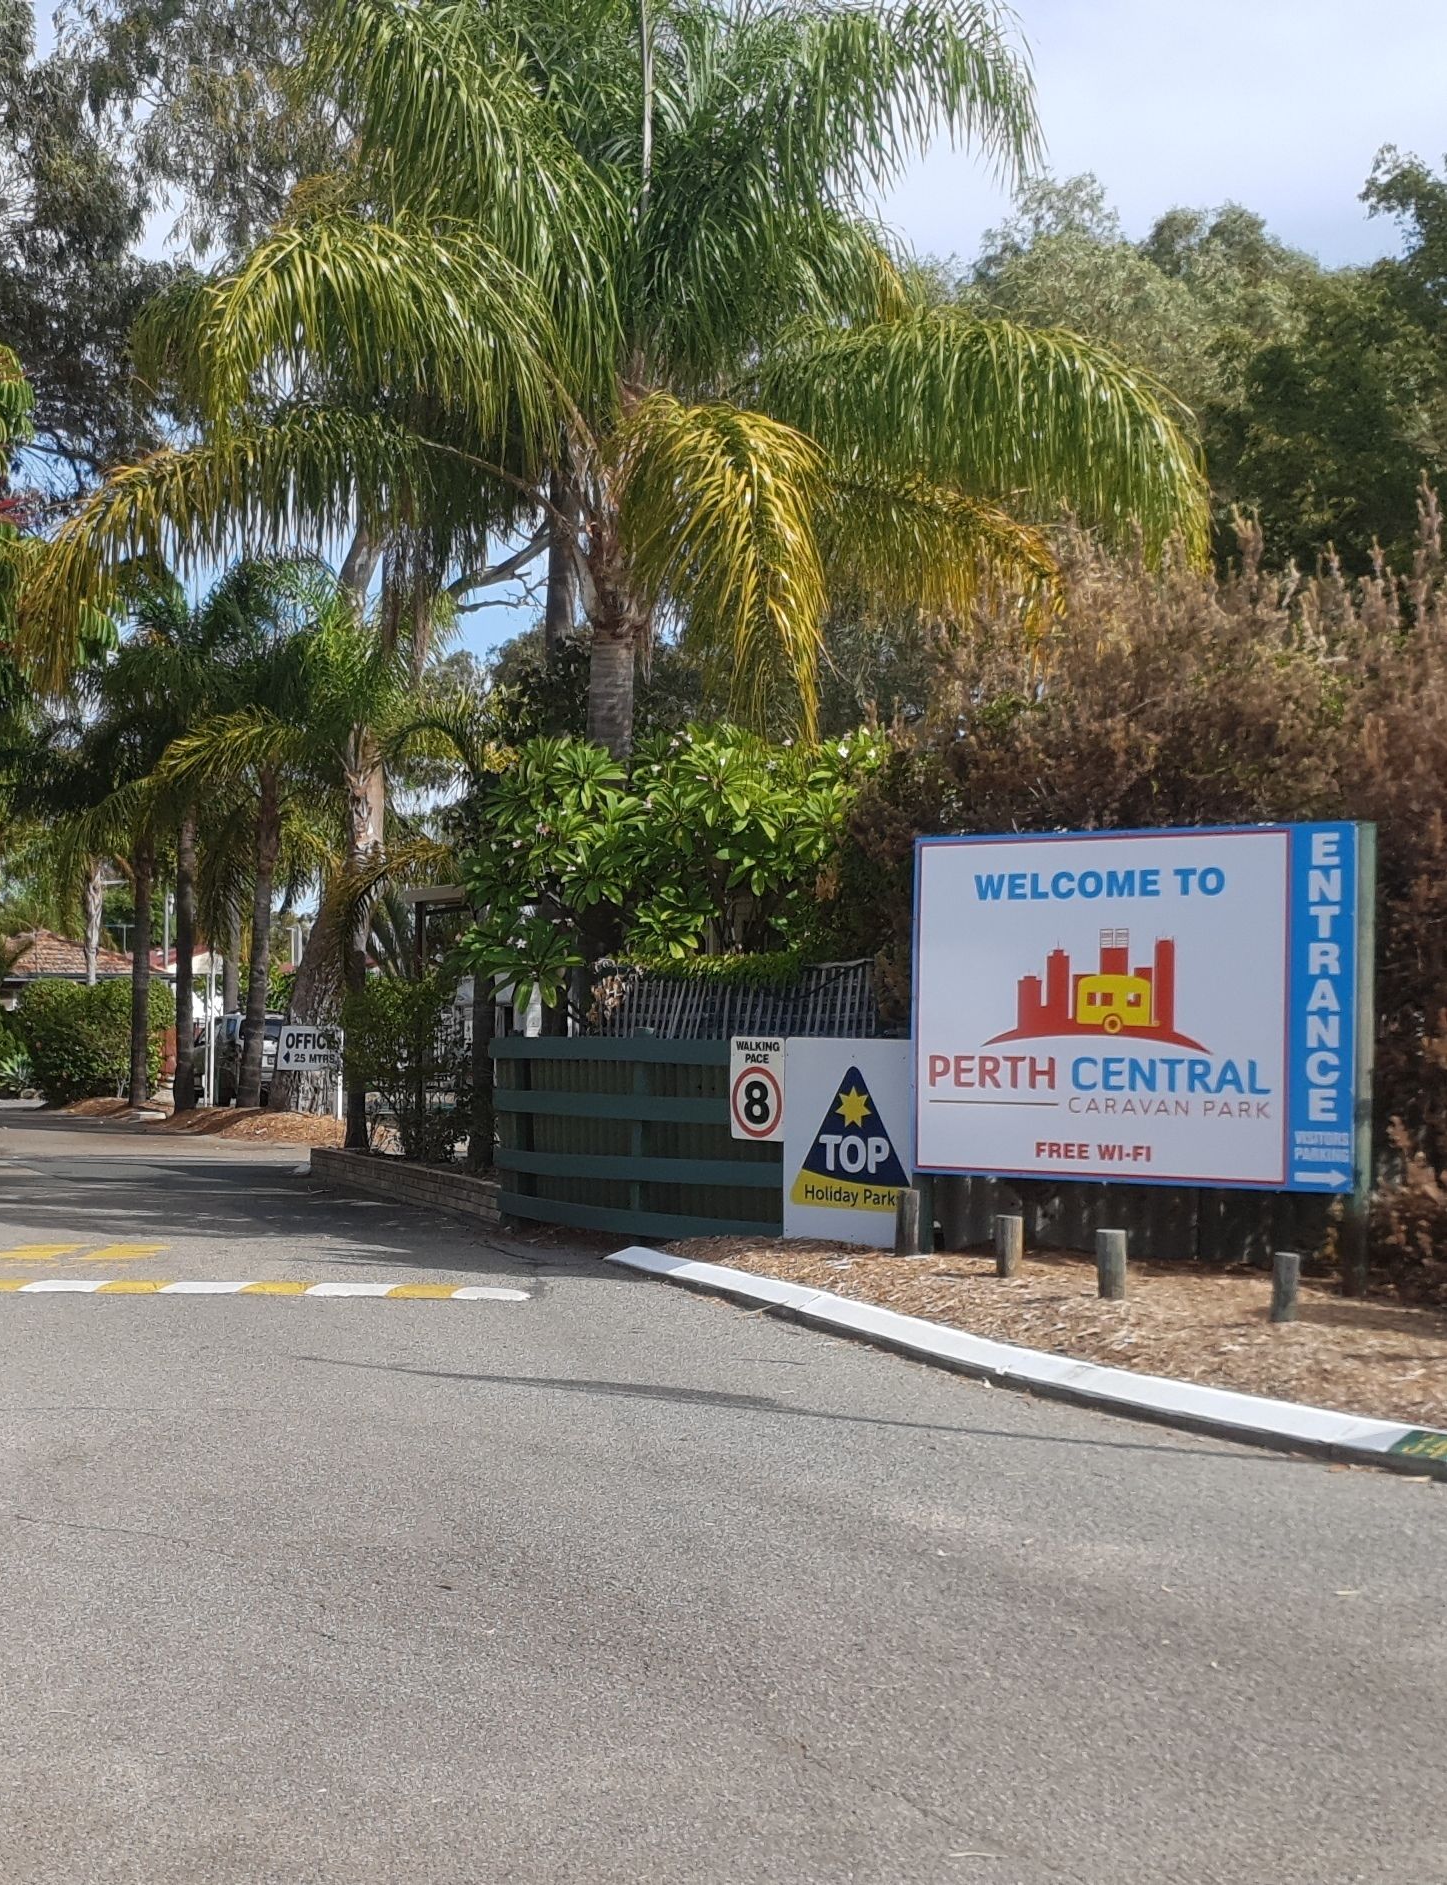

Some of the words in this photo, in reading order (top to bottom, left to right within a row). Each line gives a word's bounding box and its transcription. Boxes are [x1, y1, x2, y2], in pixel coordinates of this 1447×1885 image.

[974, 869, 1161, 901] WELCOME
[1174, 867, 1225, 896] TO
[1305, 832, 1342, 1122] ENTRANCE
[285, 1032, 335, 1050] OFFIC
[736, 1040, 780, 1052] WALKING
[294, 1053, 306, 1063] 25
[308, 1053, 335, 1064] MTRS
[744, 1053, 770, 1064] PACE
[929, 1054, 1056, 1090] PERTH
[1071, 1056, 1272, 1095] CENTRAL
[744, 1080, 770, 1125] 8
[1068, 1096, 1190, 1117] CARAVAN
[1203, 1100, 1272, 1120] PARK
[819, 1134, 890, 1174] TOP
[1035, 1141, 1089, 1161] FREE
[1097, 1143, 1152, 1163] WI-FI
[804, 1183, 859, 1208] Holiday
[863, 1188, 899, 1207] Park
